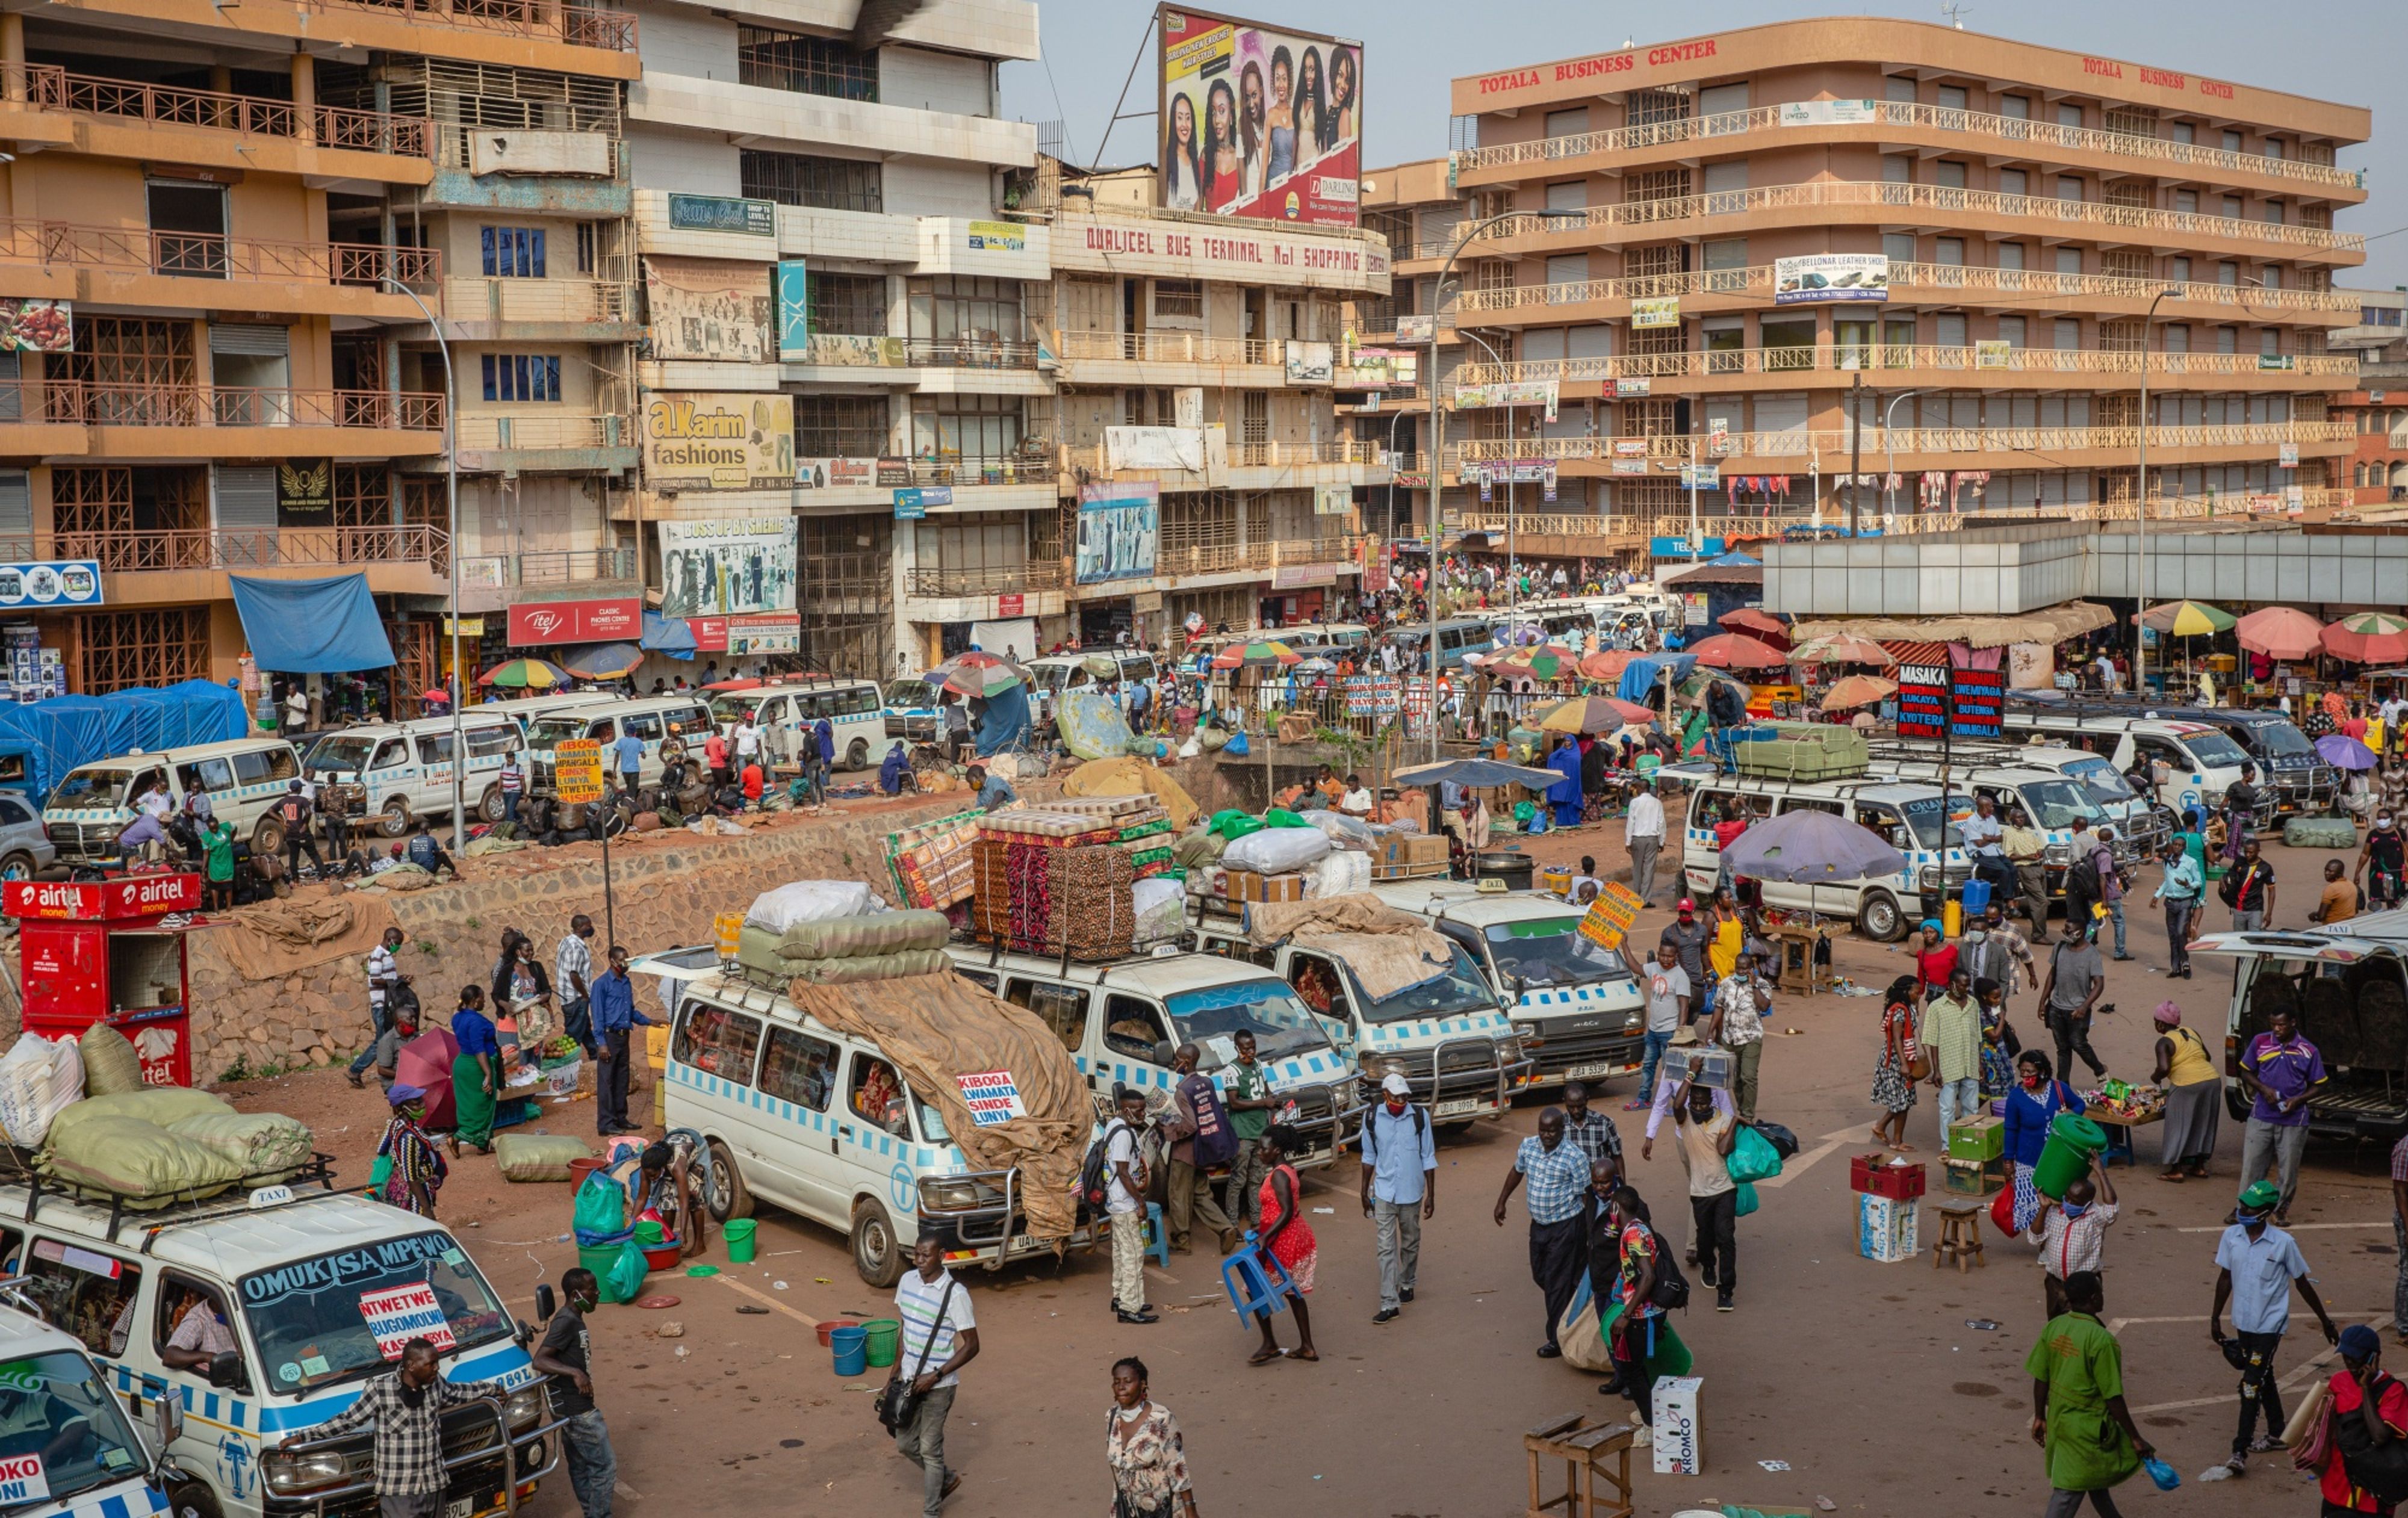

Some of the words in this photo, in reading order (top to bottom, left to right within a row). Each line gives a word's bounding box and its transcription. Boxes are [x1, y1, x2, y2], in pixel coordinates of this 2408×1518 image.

[1191, 40, 1203, 53] NEW
[1204, 29, 1230, 48] CROCHET
[1182, 57, 1197, 70] HAIR
[1197, 48, 1217, 63] STYLES
[1480, 71, 1540, 94] TOTALA
[1556, 55, 1633, 81] BUSINESS
[1648, 40, 1716, 66] CENTER
[2083, 58, 2122, 79] TOTALA
[2140, 68, 2185, 90] BUSINESS
[2200, 81, 2234, 99] CENTER
[1322, 180, 1356, 194] DARLING
[1087, 228, 1154, 254] QUALICEL
[1167, 235, 1191, 256] BUS
[1203, 238, 1262, 263] TERMINAL
[1305, 247, 1359, 271] SHOPPING
[1367, 253, 1385, 271] CENTER
[1839, 256, 1867, 265] LEATHER
[1869, 257, 1885, 266] SHOES
[649, 399, 746, 440] a.Karim
[651, 444, 745, 465] fashions
[713, 468, 748, 482] STORE
[754, 478, 763, 489] L2
[684, 521, 715, 539] BOSS
[716, 520, 732, 537] UP
[732, 519, 748, 536] BY
[748, 518, 784, 535] SHERIE
[533, 612, 555, 628] itel
[731, 618, 746, 627] GSM
[1900, 665, 1946, 686] MASAKA
[1902, 694, 1938, 705] LUKAYA
[1958, 704, 1995, 715] BUTENGA
[1899, 713, 1944, 726] KYOTERA
[557, 767, 591, 776] SINDE
[559, 776, 589, 785] LUNYA
[557, 784, 601, 795] NTWETWE
[40, 885, 83, 908] airtel
[140, 878, 184, 903] airtel
[41, 908, 68, 920] money
[141, 902, 169, 913] money
[958, 1074, 1011, 1089] KIBOGA
[1249, 1073, 1265, 1100] 24
[963, 1086, 1019, 1100] LWAMATA
[969, 1098, 1013, 1112] SINDE
[973, 1109, 1012, 1124] LUNYA
[258, 1188, 286, 1203] TAXI
[1878, 1202, 1888, 1229] Cape
[1878, 1231, 1887, 1257] Crisp
[245, 1249, 379, 1302] OMUKISA
[376, 1233, 449, 1266] MPEWO
[359, 1290, 436, 1318] NTWETWE
[368, 1308, 445, 1337] BUGOMOLWA
[283, 1368, 299, 1380] PSV
[1680, 1417, 1692, 1474] KROMCO
